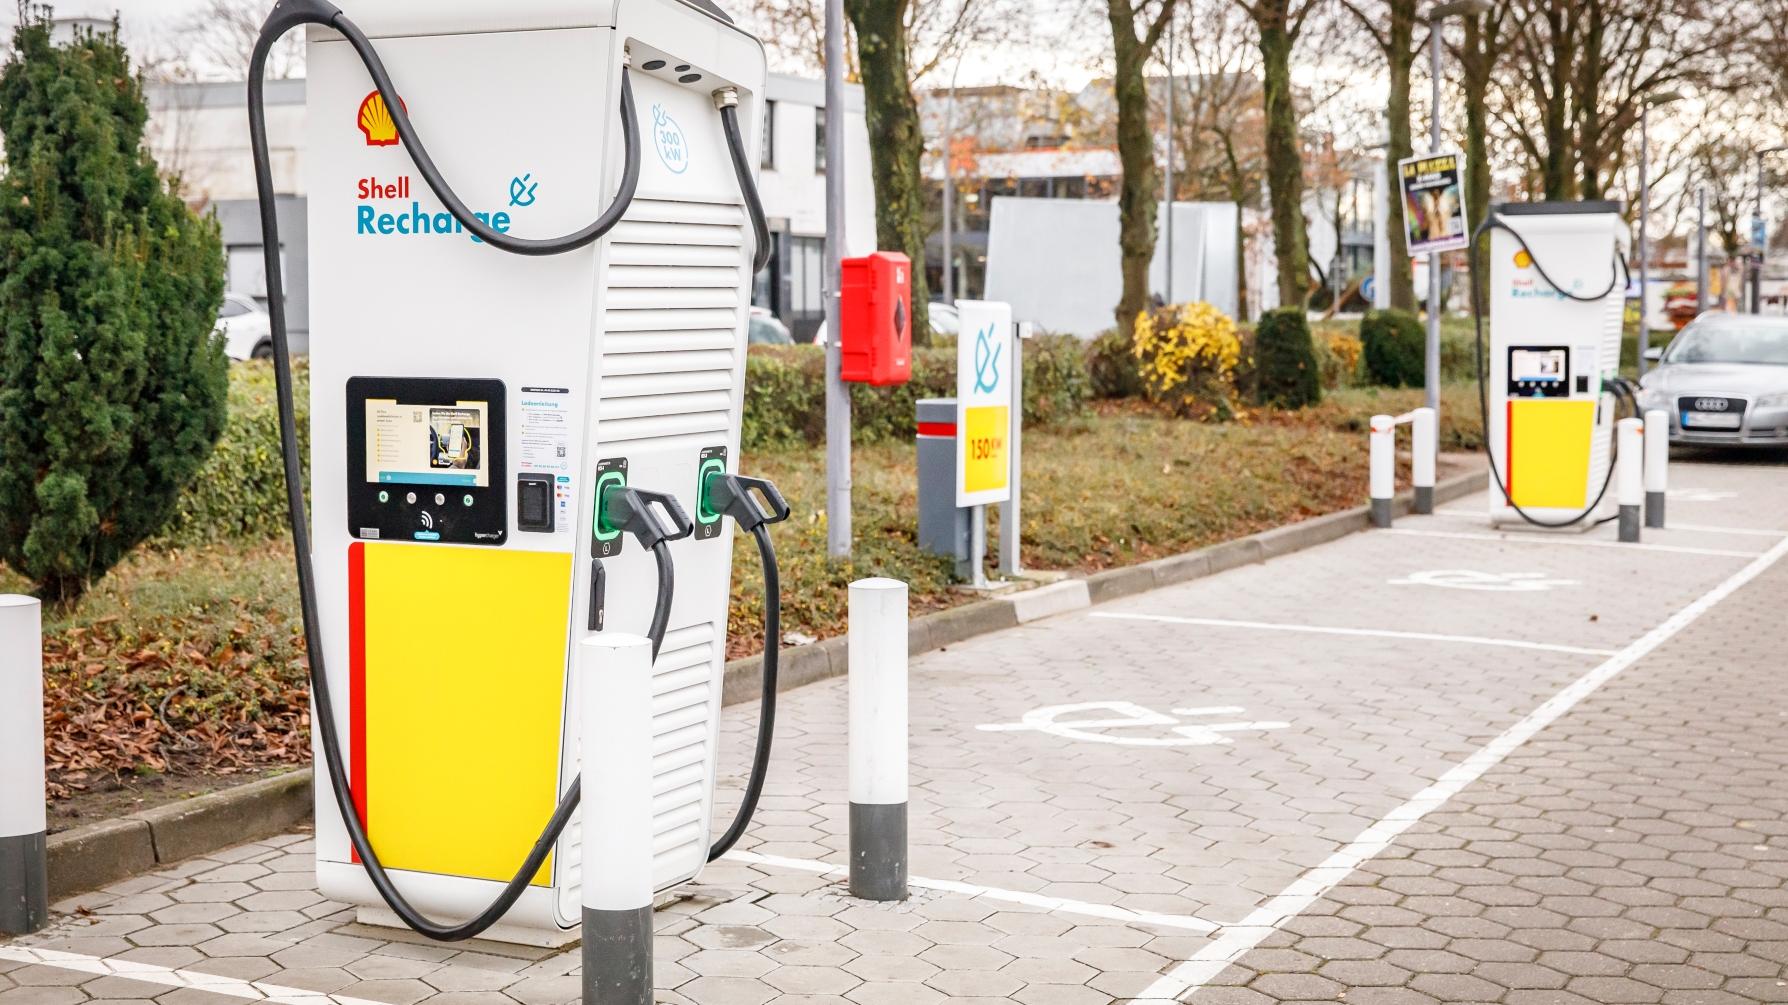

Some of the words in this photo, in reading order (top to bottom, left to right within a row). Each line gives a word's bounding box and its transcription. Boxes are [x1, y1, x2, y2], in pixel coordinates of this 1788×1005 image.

[660, 130, 680, 146] 300
[664, 145, 681, 161] kW
[357, 176, 409, 200] Shell
[971, 438, 990, 460] 150
